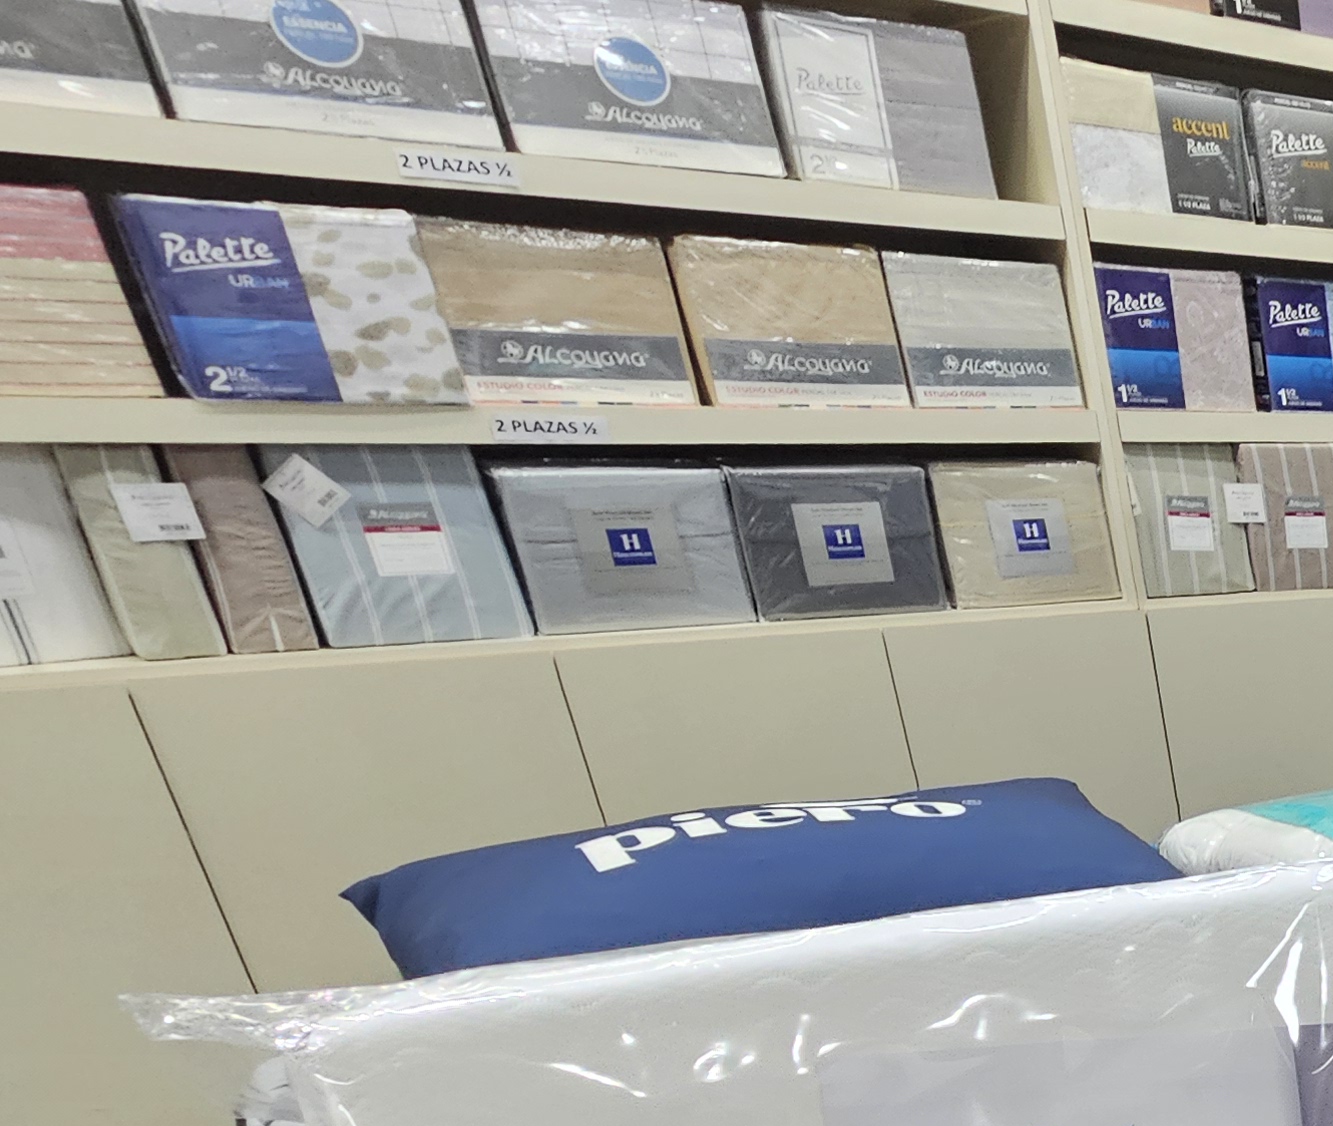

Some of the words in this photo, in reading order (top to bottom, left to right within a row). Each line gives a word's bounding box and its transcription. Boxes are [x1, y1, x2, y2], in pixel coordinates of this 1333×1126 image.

[796, 67, 863, 91] Palette
[1172, 117, 1230, 140] accent
[1187, 138, 1221, 153] Palette
[1270, 130, 1325, 153] Palette
[400, 155, 412, 169] 2
[417, 155, 490, 176] PLAZAS
[160, 232, 275, 268] Palette
[228, 274, 289, 289] URBAN
[1106, 290, 1165, 315] Palette
[1269, 300, 1320, 323] Palette
[1138, 318, 1170, 329] URBAN
[205, 366, 232, 392] 2
[495, 419, 507, 432] 2
[512, 419, 578, 434] PLAZAS
[834, 529, 851, 544] H
[1023, 522, 1039, 538] H
[620, 534, 641, 550] H
[574, 801, 966, 873] piero
